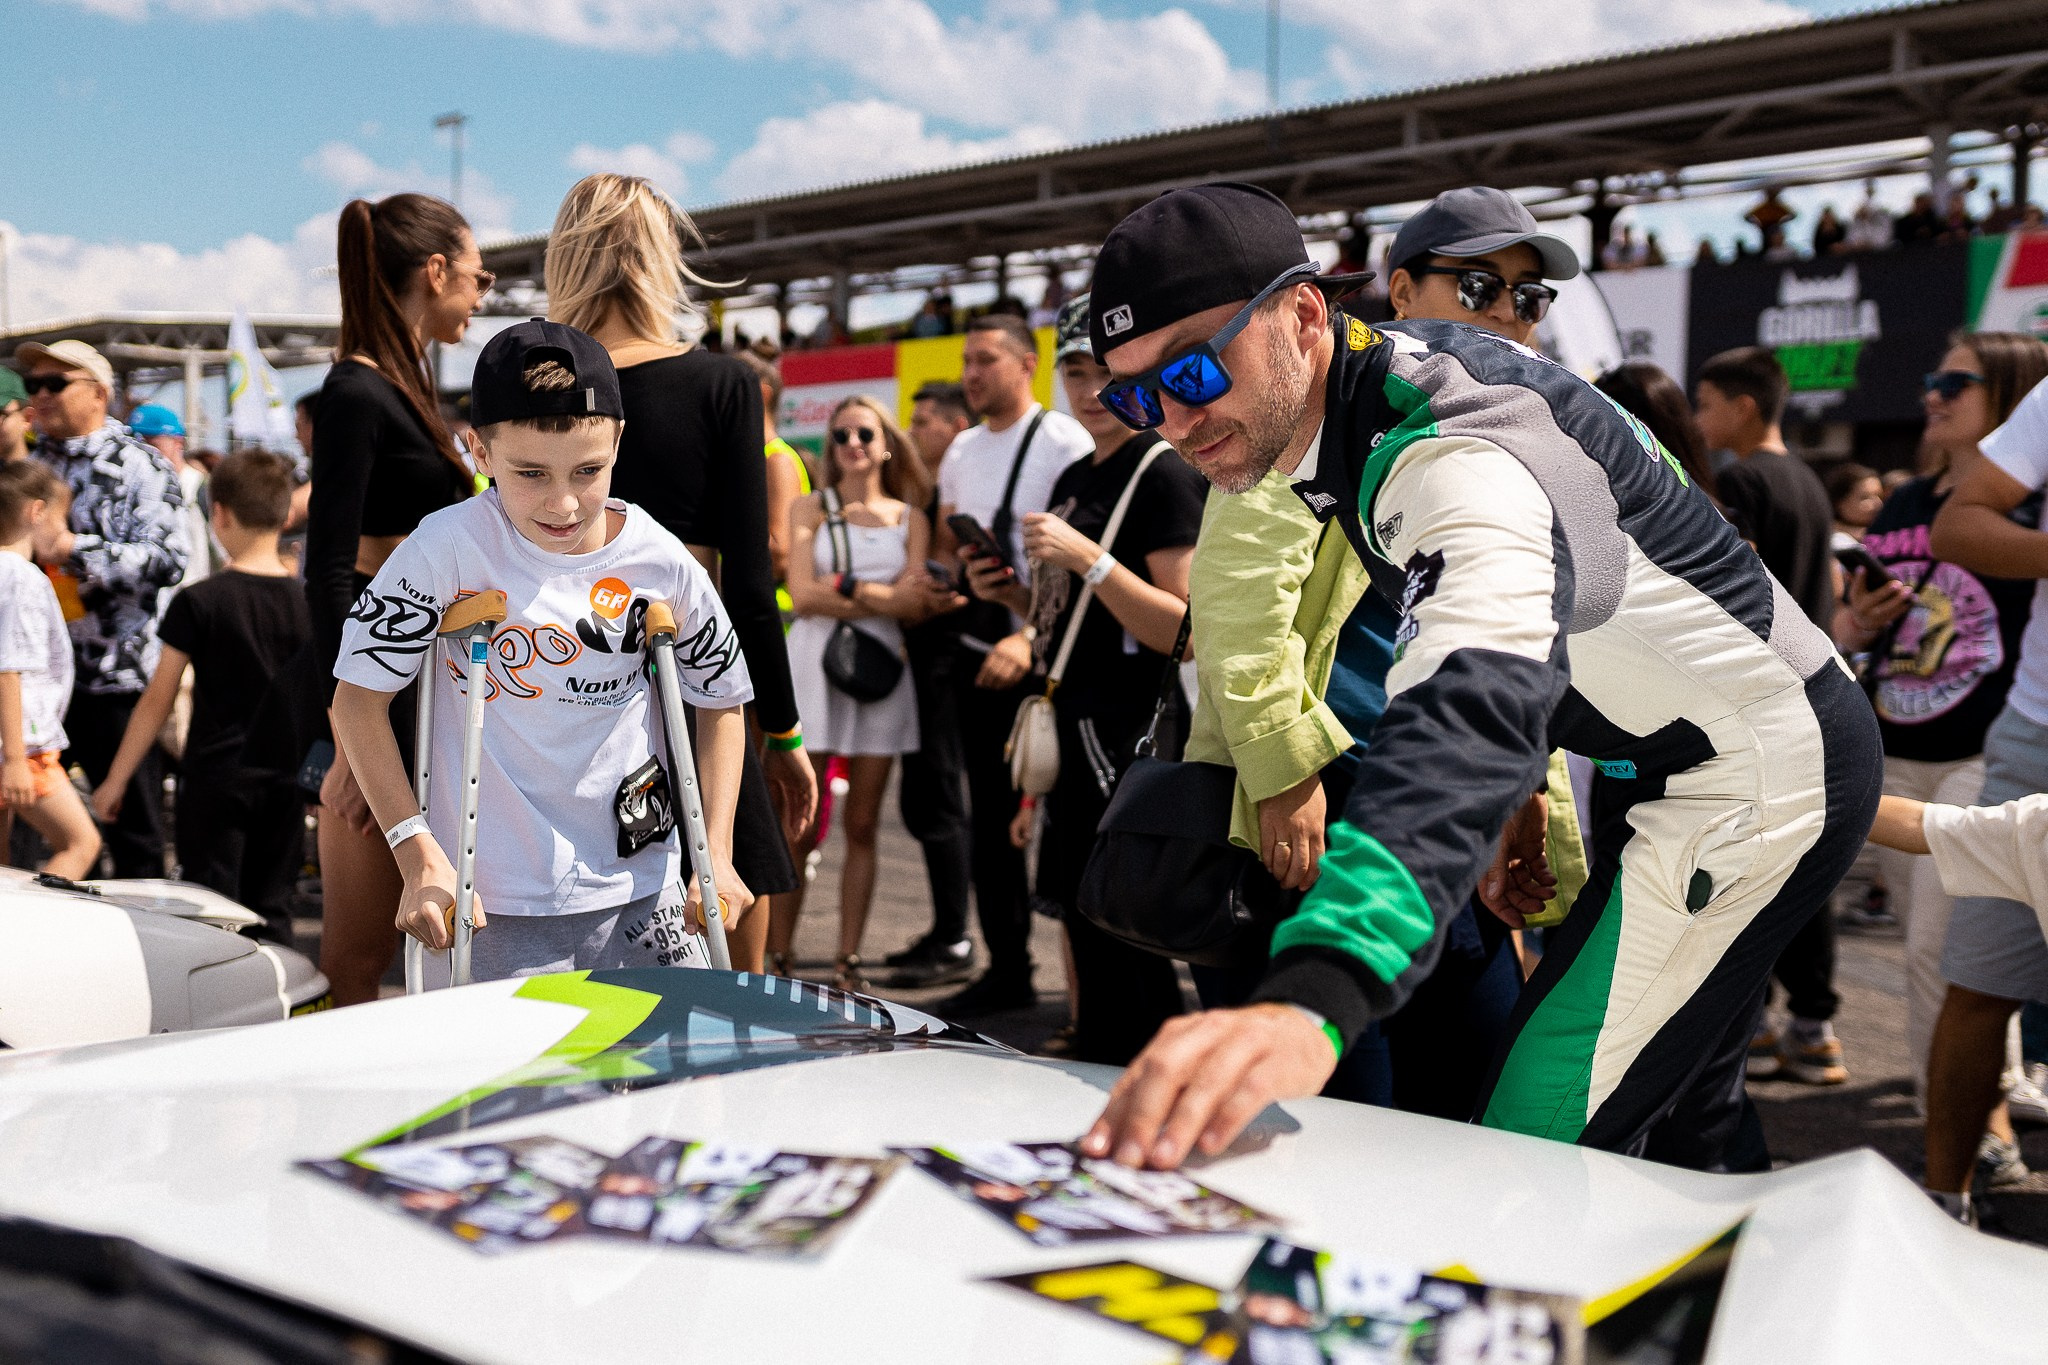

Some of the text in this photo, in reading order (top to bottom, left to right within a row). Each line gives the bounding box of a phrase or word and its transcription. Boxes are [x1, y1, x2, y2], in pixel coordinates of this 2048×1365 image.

[397, 577, 436, 604] Now
[594, 588, 628, 609] GR
[566, 677, 622, 693] Now
[624, 920, 649, 944] ALL
[657, 942, 693, 966] SPORT
